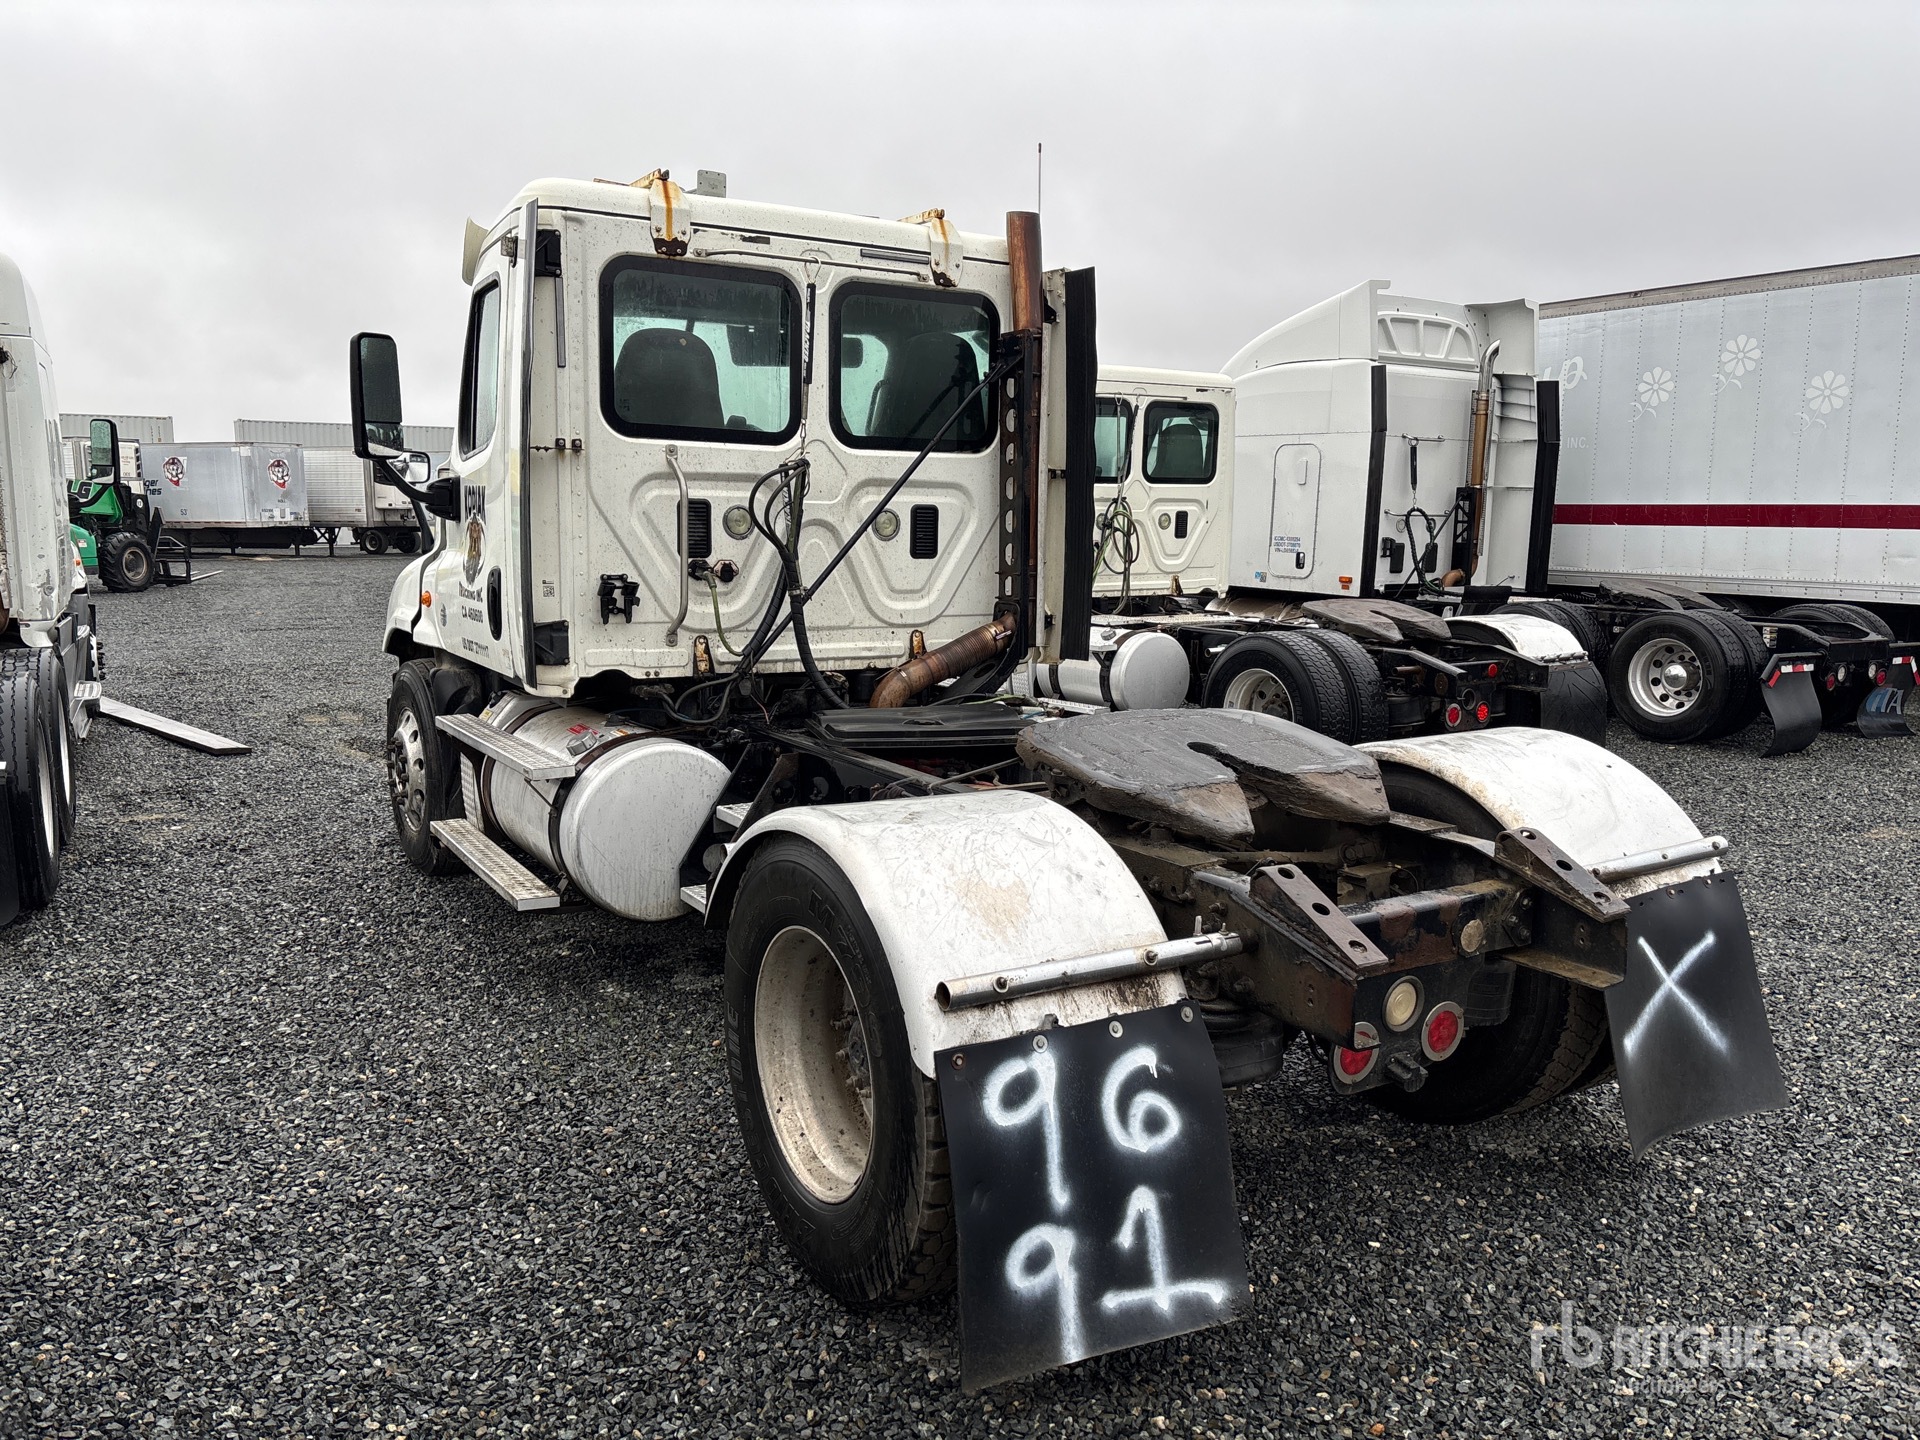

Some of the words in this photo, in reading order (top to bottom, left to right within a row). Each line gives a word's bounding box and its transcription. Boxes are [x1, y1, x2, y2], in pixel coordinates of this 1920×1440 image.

[1567, 436, 1589, 449] INC.
[463, 484, 487, 526] KODIAK
[458, 580, 476, 601] TRUCKING
[461, 605, 468, 618] CA
